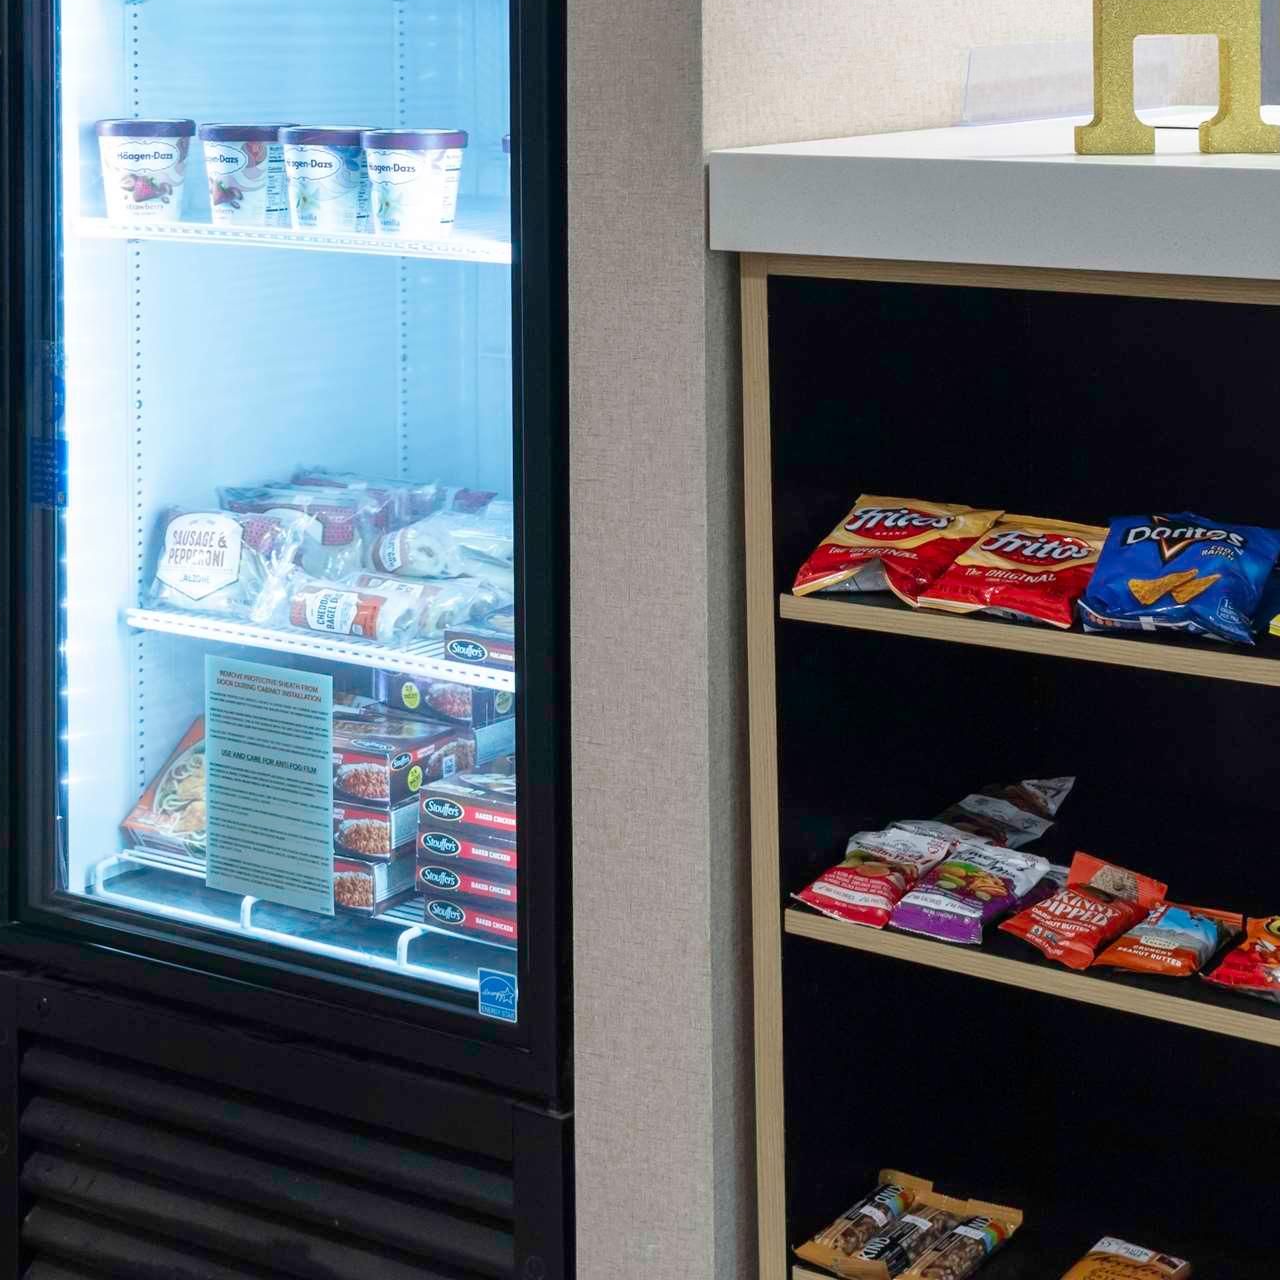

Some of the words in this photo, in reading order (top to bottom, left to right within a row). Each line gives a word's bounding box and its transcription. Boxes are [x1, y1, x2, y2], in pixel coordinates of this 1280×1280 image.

[845, 507, 955, 531] Fritos
[172, 529, 216, 548] SAUSAGE
[217, 533, 228, 549] &
[980, 530, 1095, 560] Fritos
[1126, 525, 1245, 548] Doritos
[985, 569, 1057, 584] ORIGINAL
[232, 751, 245, 760] AND
[427, 800, 460, 817] Stouffer's
[425, 834, 457, 852] Stouffer's
[471, 847, 489, 858] BAKED
[424, 868, 456, 886] Stouffer's
[471, 881, 489, 892] BAKED
[431, 903, 460, 920] Stouffer's
[1057, 890, 1120, 918] KINNY
[1150, 953, 1183, 968] BUTTER
[858, 1236, 890, 1261] KIND
